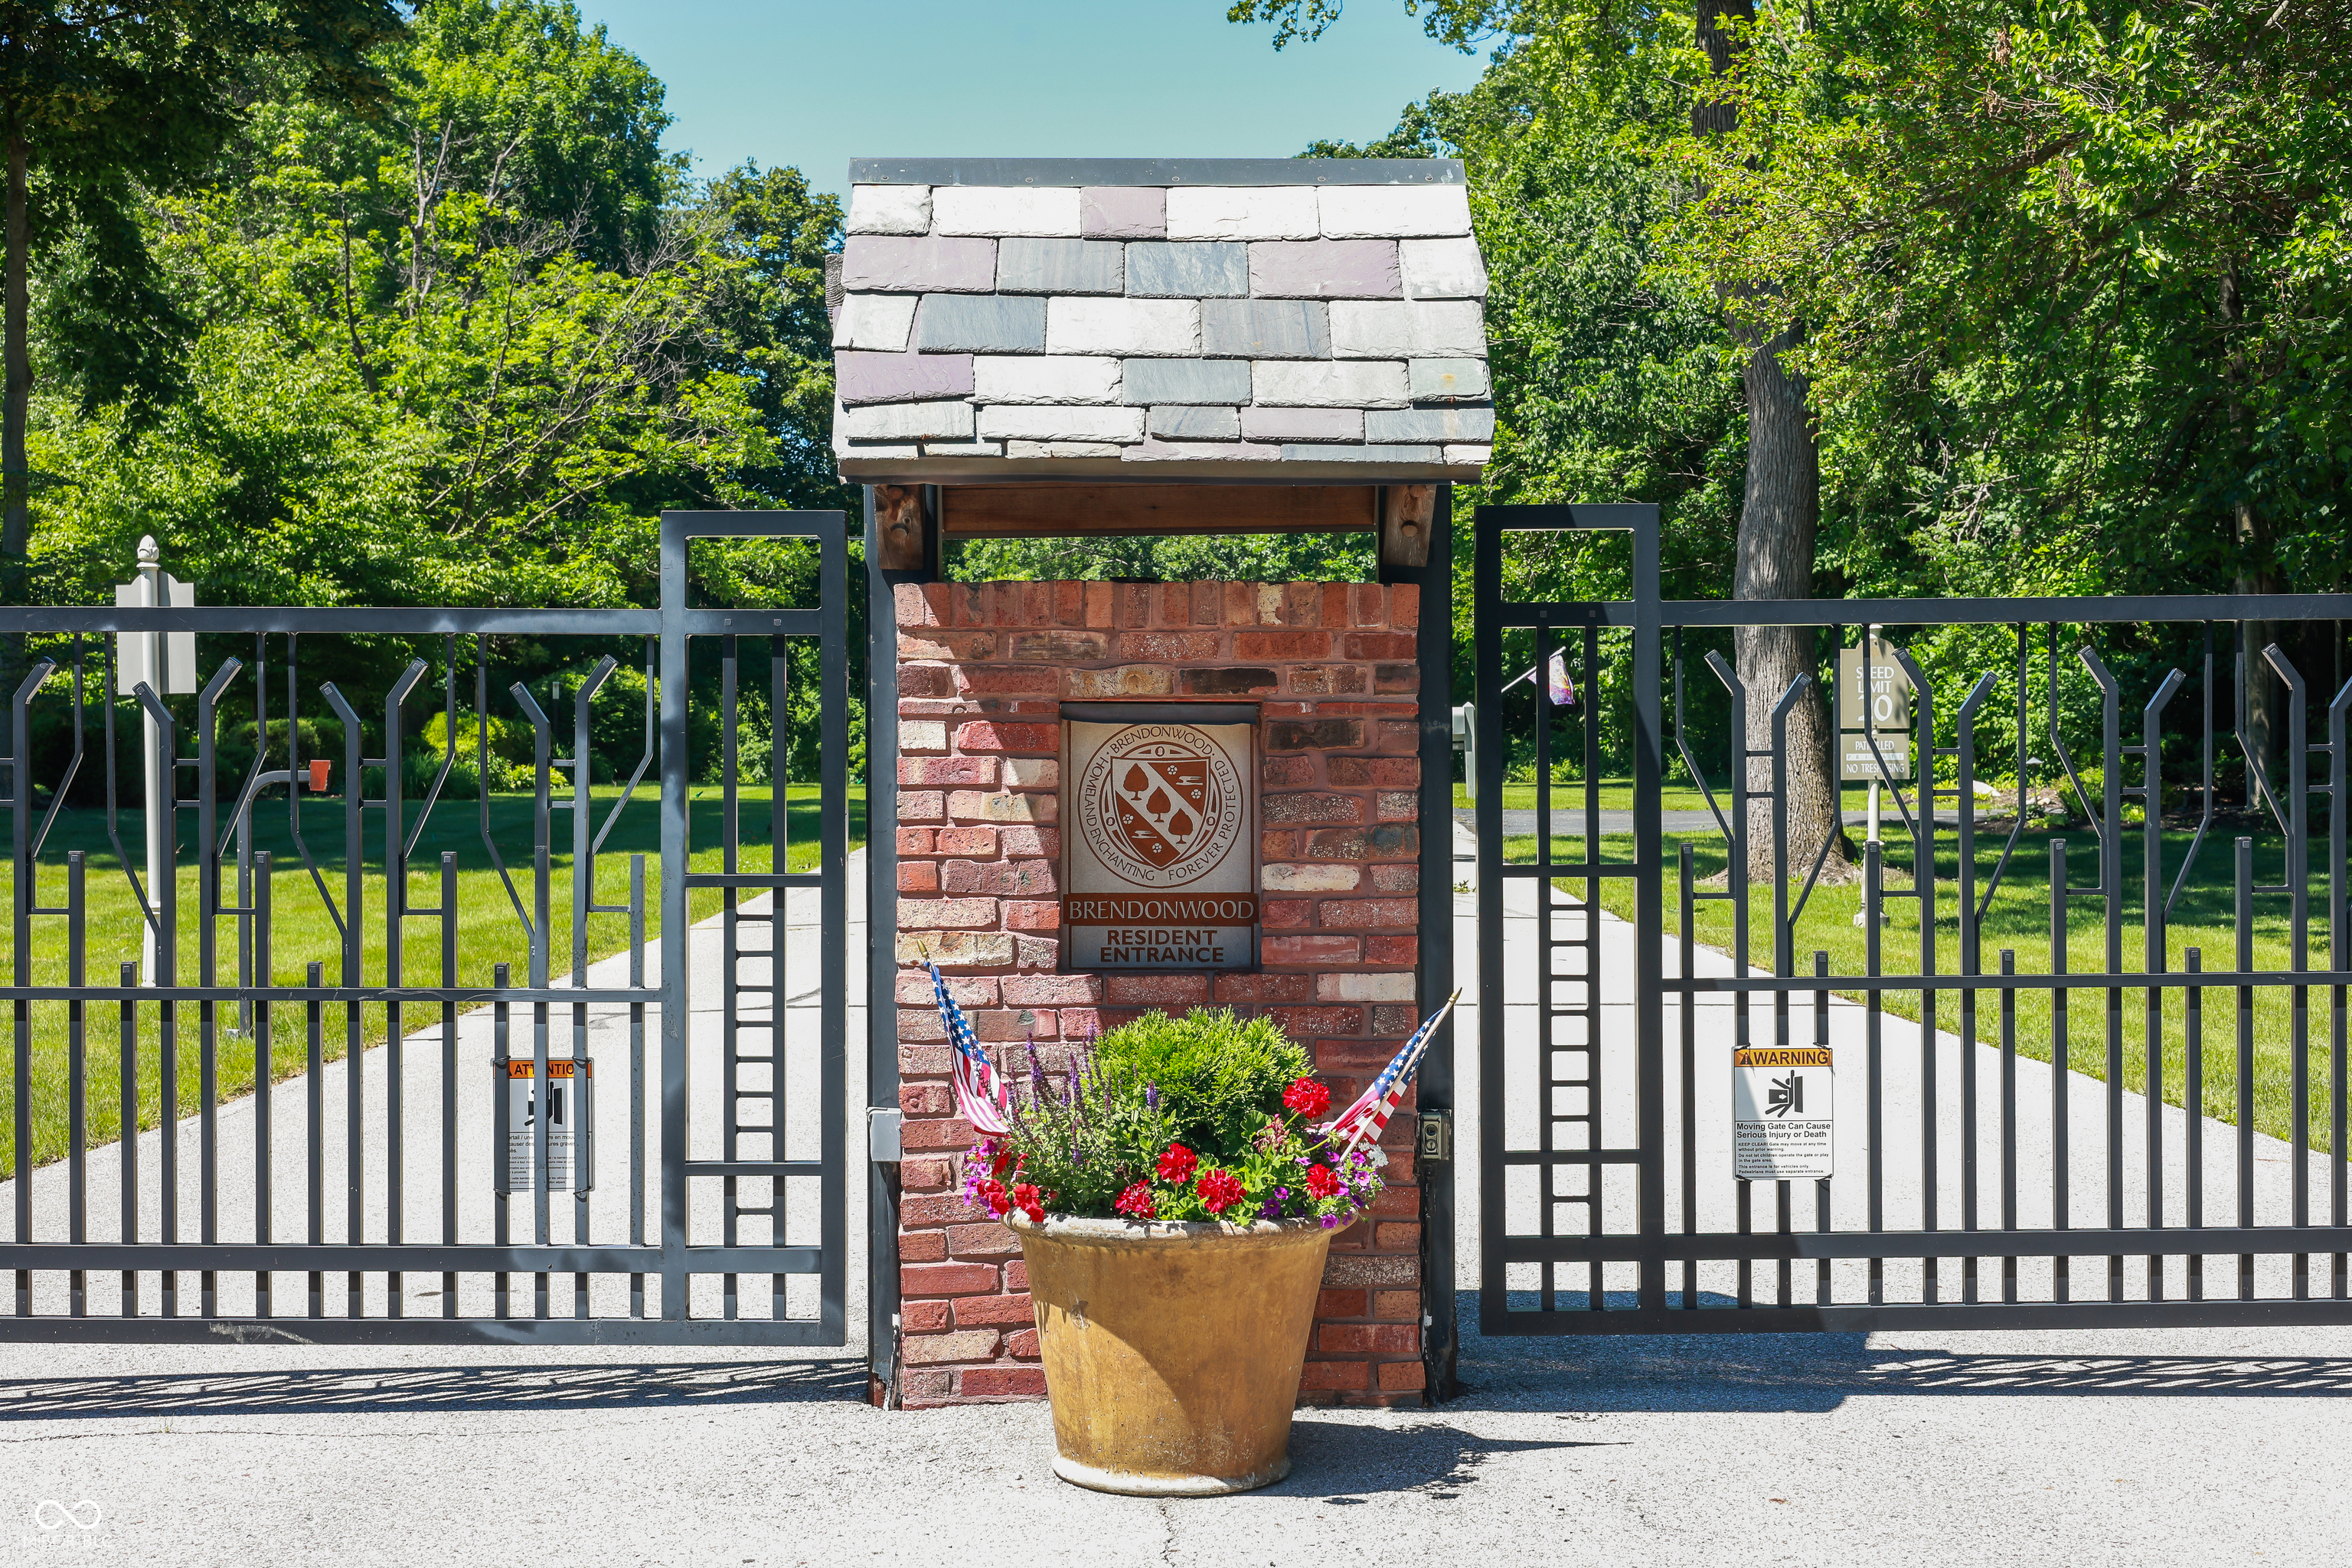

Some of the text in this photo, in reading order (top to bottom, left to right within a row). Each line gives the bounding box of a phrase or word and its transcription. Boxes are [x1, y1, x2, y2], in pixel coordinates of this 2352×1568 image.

[1856, 666, 1895, 679] SEED
[1857, 681, 1892, 694] LMIT
[1110, 726, 1214, 755] BRENDONWOOD
[1855, 740, 1895, 750] PATRLLED
[1846, 763, 1858, 773] NO
[1084, 756, 1236, 881] HOMELAND ENCHANTING FOREVER PROTECTED
[1069, 900, 1255, 920] BRENDONWOOD
[1107, 929, 1217, 946] RESIDENT
[1100, 947, 1224, 962] ENTRANCE
[1753, 1051, 1828, 1065] WARNING
[514, 1063, 574, 1075] ATTNTIO
[1736, 1122, 1766, 1132] Moving
[1769, 1131, 1792, 1139] Injury
